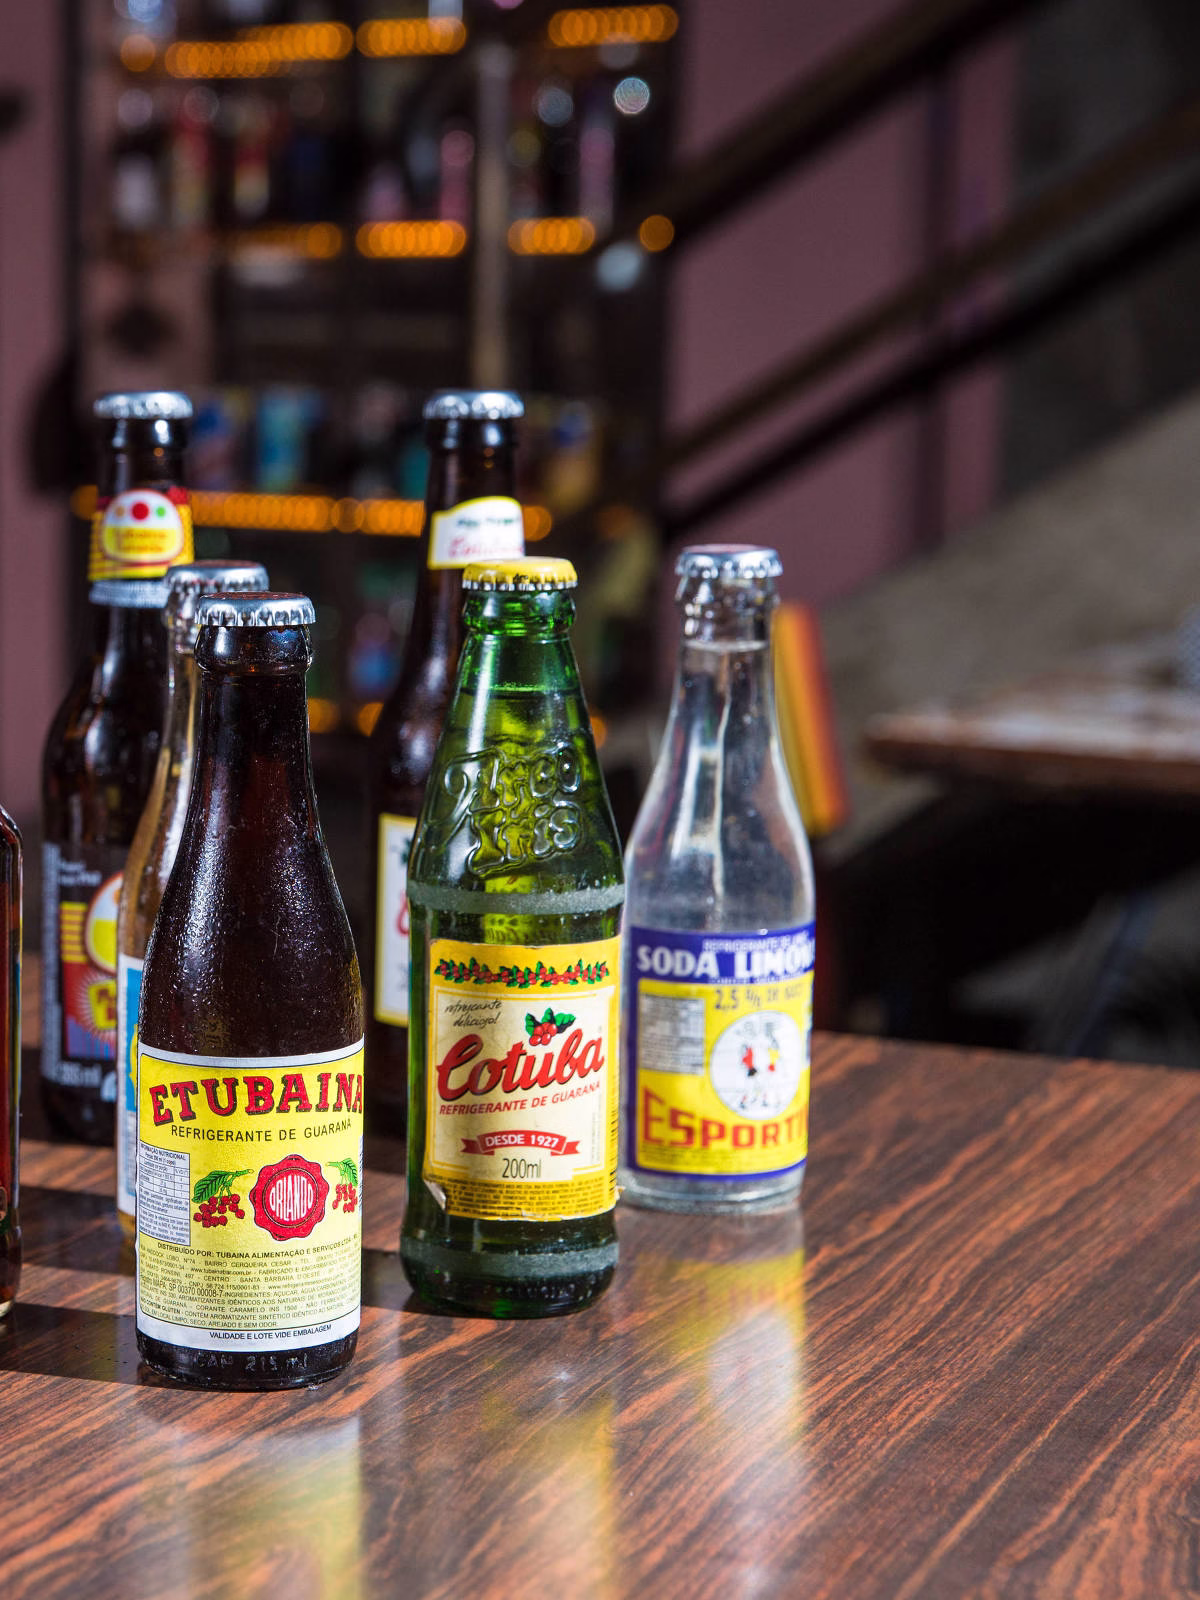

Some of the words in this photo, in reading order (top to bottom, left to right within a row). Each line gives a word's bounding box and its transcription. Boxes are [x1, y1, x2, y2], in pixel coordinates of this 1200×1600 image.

[636, 944, 720, 979] SODA
[436, 1028, 605, 1101] Cotuba
[150, 1073, 363, 1126] ETUBAINA
[439, 1099, 528, 1115] REFRIGERANTE
[531, 1096, 548, 1108] DE
[171, 1124, 272, 1142] REFRIGERANTE
[279, 1129, 296, 1140] DE
[303, 1118, 351, 1138] GUARANÁ
[484, 1134, 525, 1147] DESDE
[530, 1134, 559, 1148] 1927
[502, 1157, 542, 1179] 200ml
[270, 1175, 314, 1221] ORLANDO
[158, 1242, 195, 1256] DISTRIBUÍDO
[196, 1250, 214, 1258] POR:
[216, 1251, 250, 1259] TUBAINA
[252, 1248, 305, 1259] ALIMENTAÇÃO
[195, 1304, 226, 1312] CORANTE
[210, 1313, 257, 1321] AROMATIZANTE
[209, 1331, 245, 1340] VALIDADE
[253, 1332, 273, 1340] LOTE
[274, 1331, 292, 1339] VIDE
[293, 1325, 332, 1338] EMBALAGEM
